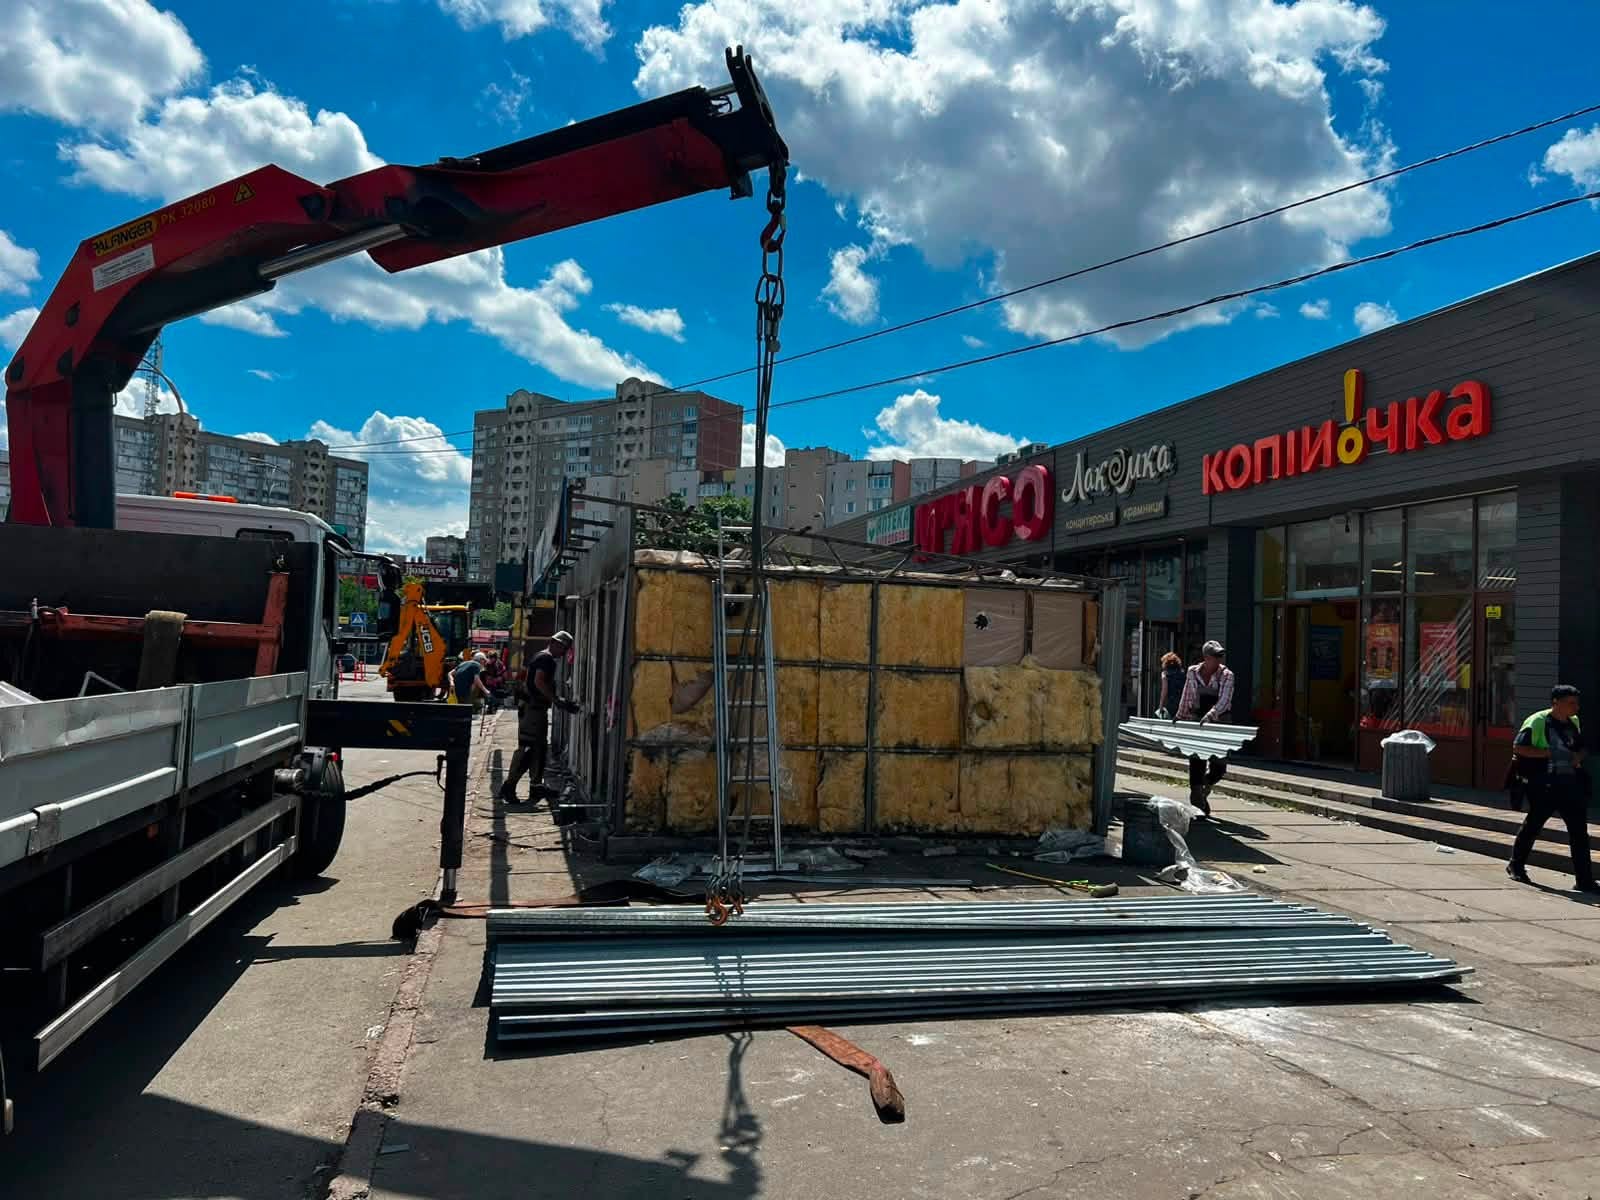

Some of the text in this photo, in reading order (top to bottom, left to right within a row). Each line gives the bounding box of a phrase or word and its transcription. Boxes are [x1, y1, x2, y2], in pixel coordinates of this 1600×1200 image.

[93, 219, 154, 253] PALFINGER
[160, 213, 177, 226] PK
[420, 625, 434, 653] JCB
